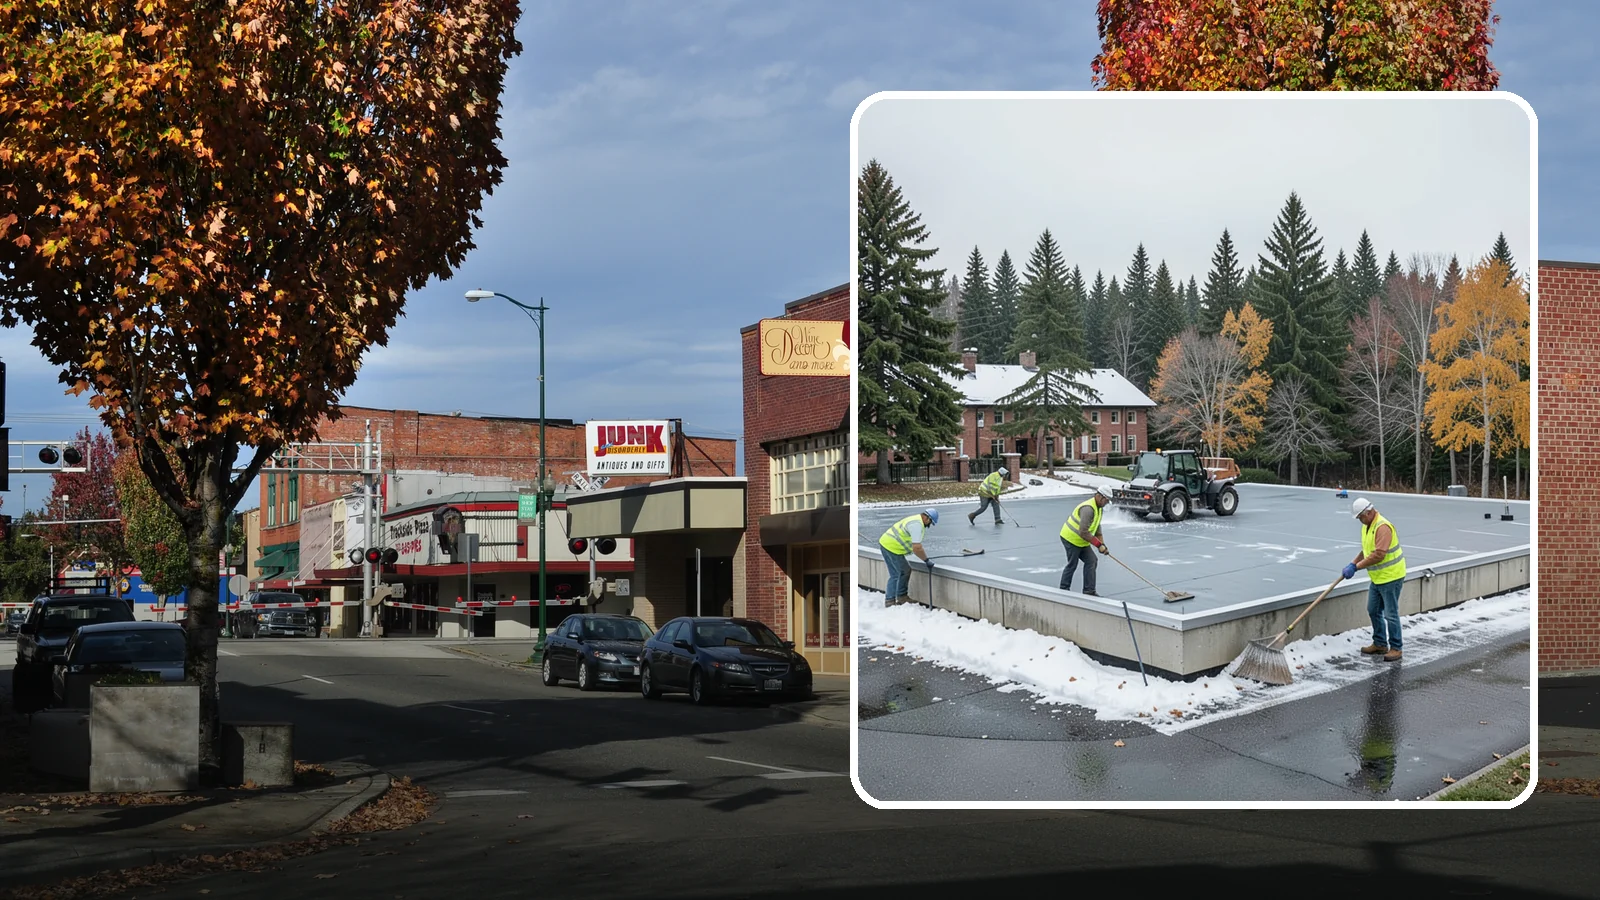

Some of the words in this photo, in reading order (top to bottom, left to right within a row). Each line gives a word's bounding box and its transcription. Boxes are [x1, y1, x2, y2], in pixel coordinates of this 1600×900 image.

[765, 328, 830, 365] Decor
[595, 425, 665, 457] JUNK
[597, 461, 628, 470] ANTIQUES
[631, 461, 644, 470] AND
[647, 460, 666, 470] GIFTS
[390, 520, 413, 540] Trackside
[414, 519, 429, 535] Pizza
